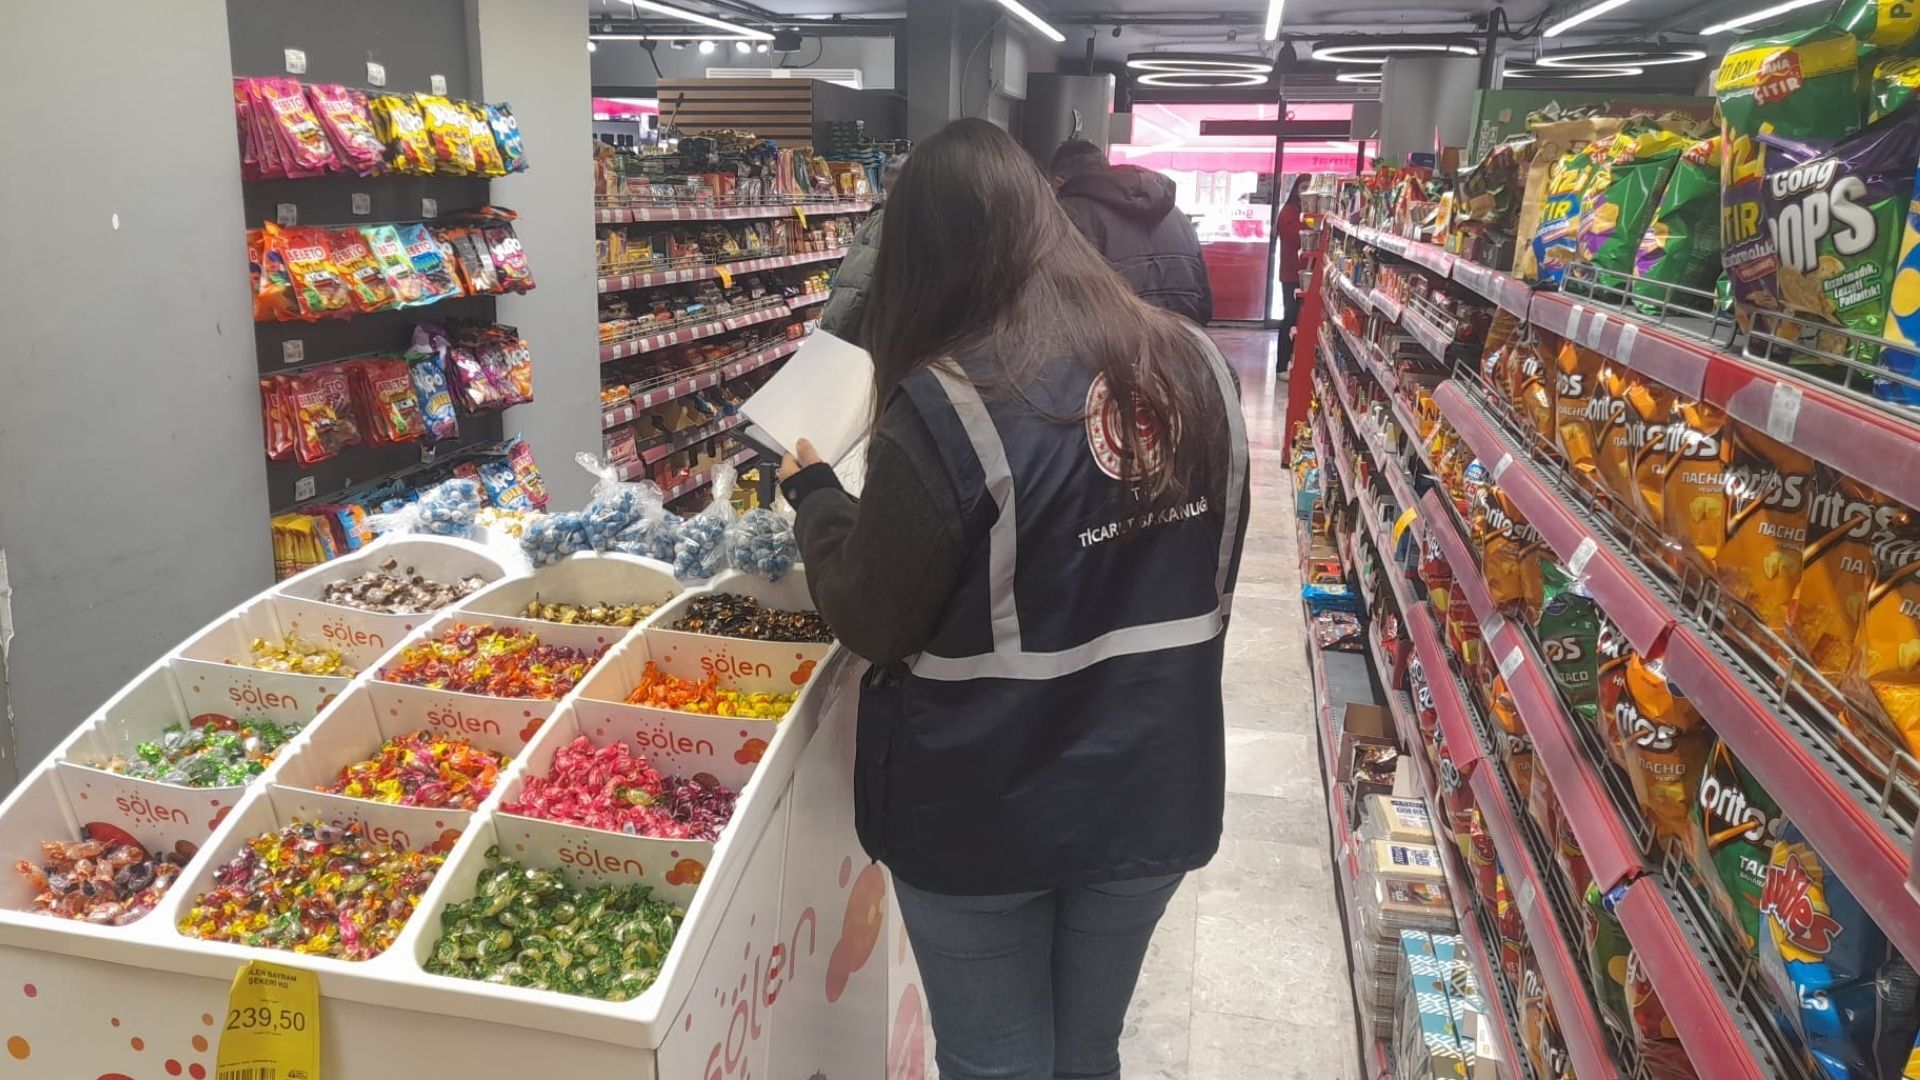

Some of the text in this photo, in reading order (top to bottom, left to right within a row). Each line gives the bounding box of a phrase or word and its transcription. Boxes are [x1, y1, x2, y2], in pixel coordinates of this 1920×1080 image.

[1763, 57, 1792, 76] AHA
[1772, 157, 1838, 199] Gong
[1077, 516, 1135, 548] TİCART
[226, 1006, 306, 1032] 239,50
